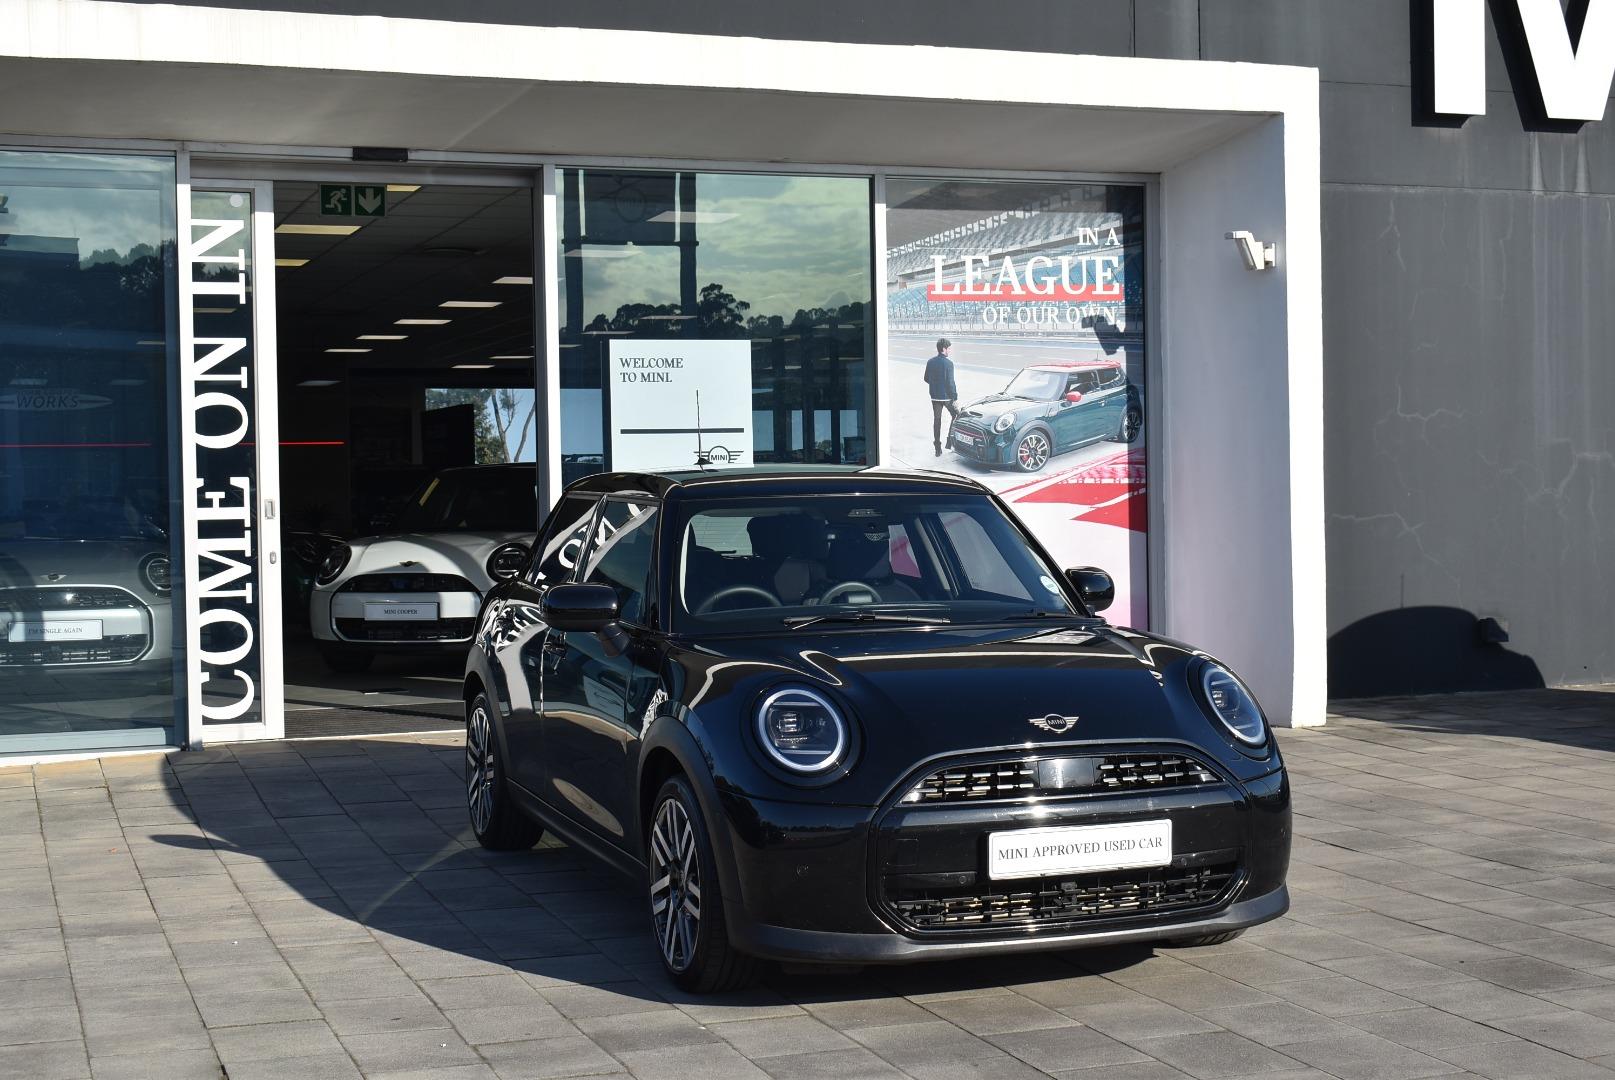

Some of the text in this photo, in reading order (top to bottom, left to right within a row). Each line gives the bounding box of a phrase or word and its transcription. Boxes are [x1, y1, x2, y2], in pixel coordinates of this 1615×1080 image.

[1078, 227, 1121, 246] IN A
[930, 254, 1120, 296] LEAGUE
[982, 306, 1012, 325] OF
[1017, 306, 1060, 324] OUR
[619, 357, 684, 369] WELCOME
[620, 372, 637, 383] TO
[16, 393, 79, 409] WORKS
[193, 337, 249, 449] ON
[197, 476, 256, 720] COME
[1047, 718, 1066, 726] MINI
[998, 836, 1163, 861] MINI APPROVED USED CAR
